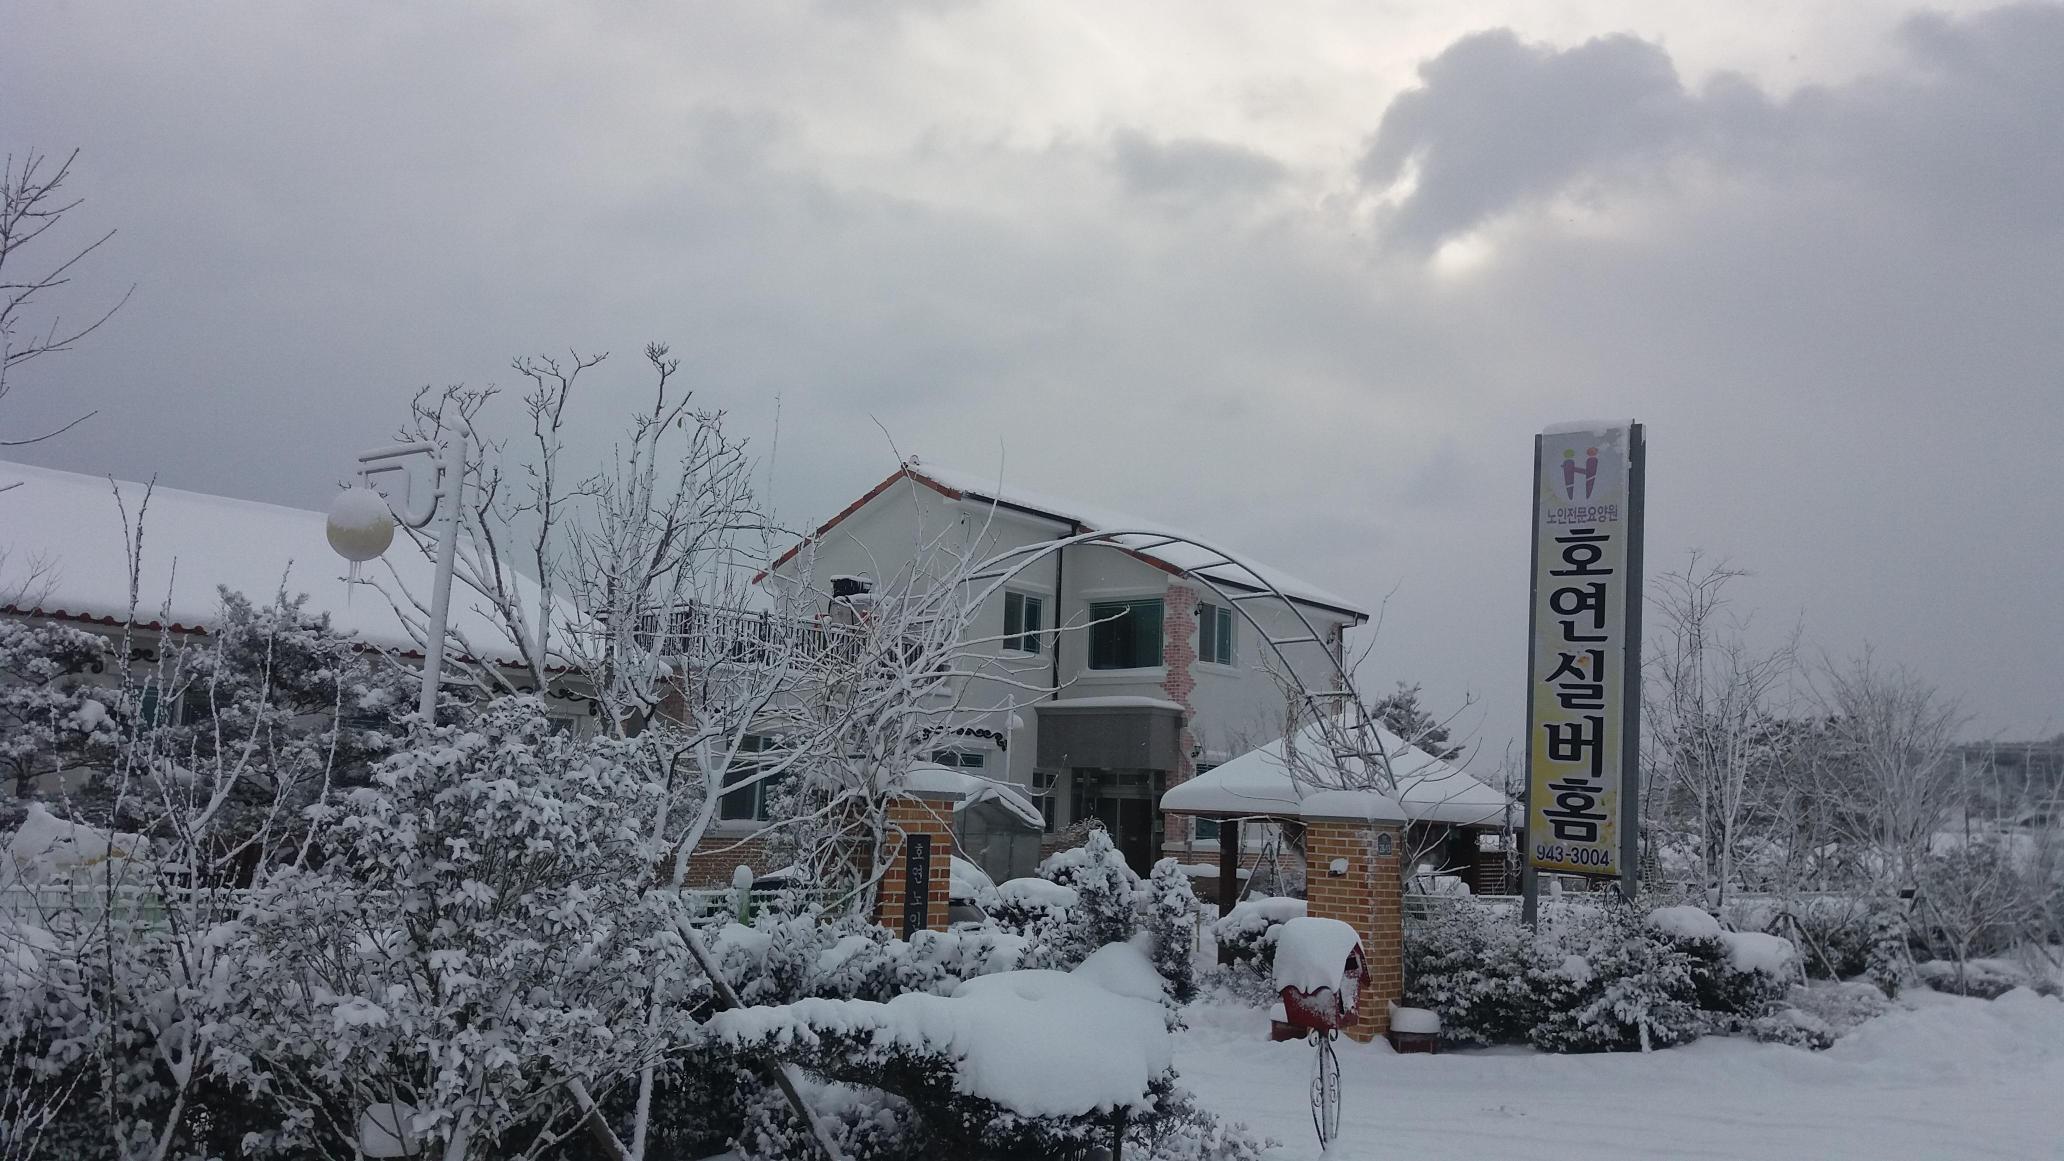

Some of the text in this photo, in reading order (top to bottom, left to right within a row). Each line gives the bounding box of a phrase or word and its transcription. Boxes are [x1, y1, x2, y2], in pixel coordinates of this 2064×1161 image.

[1546, 504, 1618, 524] 노인전문요양원
[1543, 528, 1614, 843] 호연실버홈
[1536, 845, 1610, 866] 943-3004
